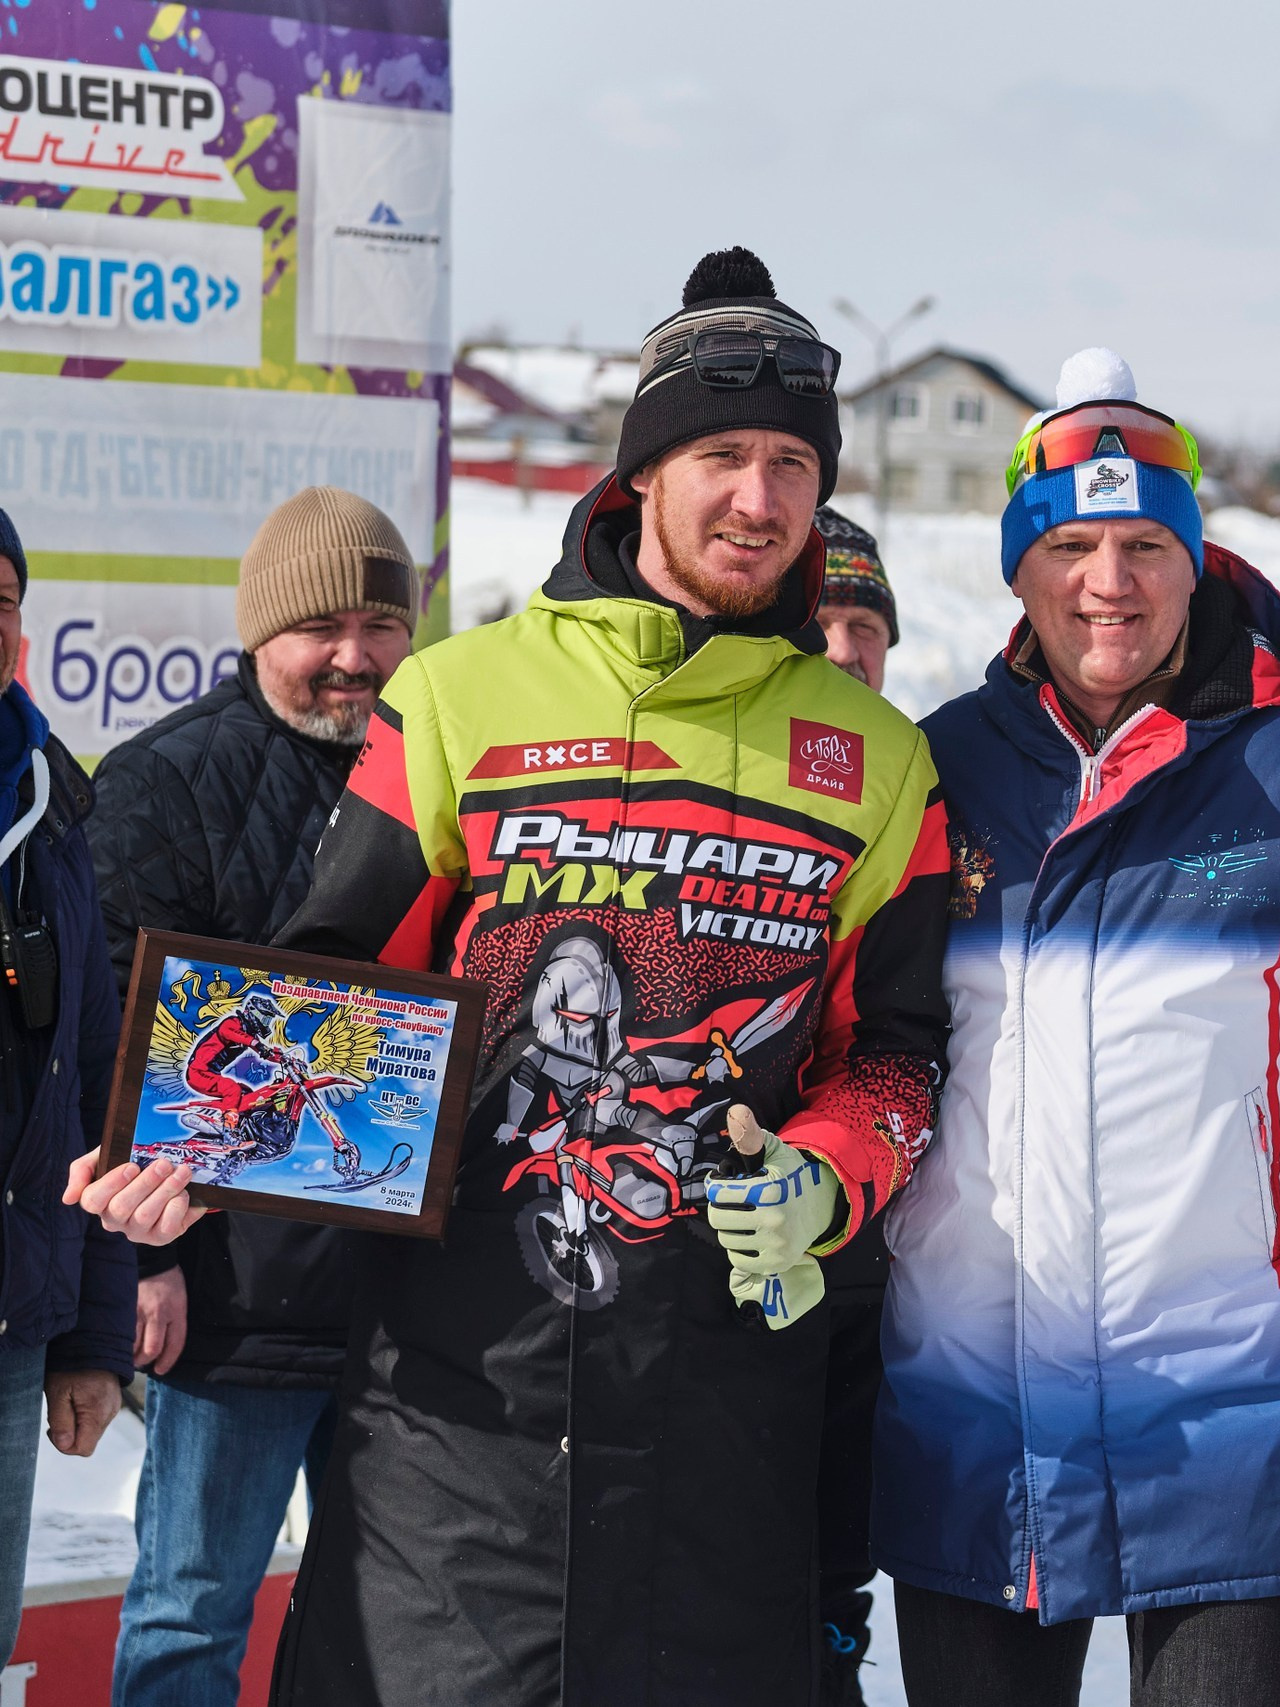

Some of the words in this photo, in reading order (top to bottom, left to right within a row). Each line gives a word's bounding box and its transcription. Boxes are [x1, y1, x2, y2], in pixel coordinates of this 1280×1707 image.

[0, 250, 239, 324] алгаз»
[116, 714, 157, 731] рек
[807, 774, 845, 790] ДРАЙВ
[678, 875, 818, 919] DEATH
[809, 908, 828, 921] OR
[681, 903, 824, 950] VICTORY
[272, 981, 350, 1004] Поздравляем
[351, 996, 406, 1013] Чемпиона
[408, 1001, 448, 1019] России
[351, 1013, 362, 1023] по
[365, 1014, 444, 1036] кросс-сноубайку
[378, 1040, 432, 1062] Тимура
[366, 1057, 437, 1081] Муратова
[381, 1091, 396, 1104] ЦТ
[405, 1095, 420, 1106] ВС
[380, 1186, 387, 1194] 8
[388, 1188, 416, 1199] марта
[704, 1160, 822, 1208] COTT
[384, 1197, 414, 1209] 2024г.
